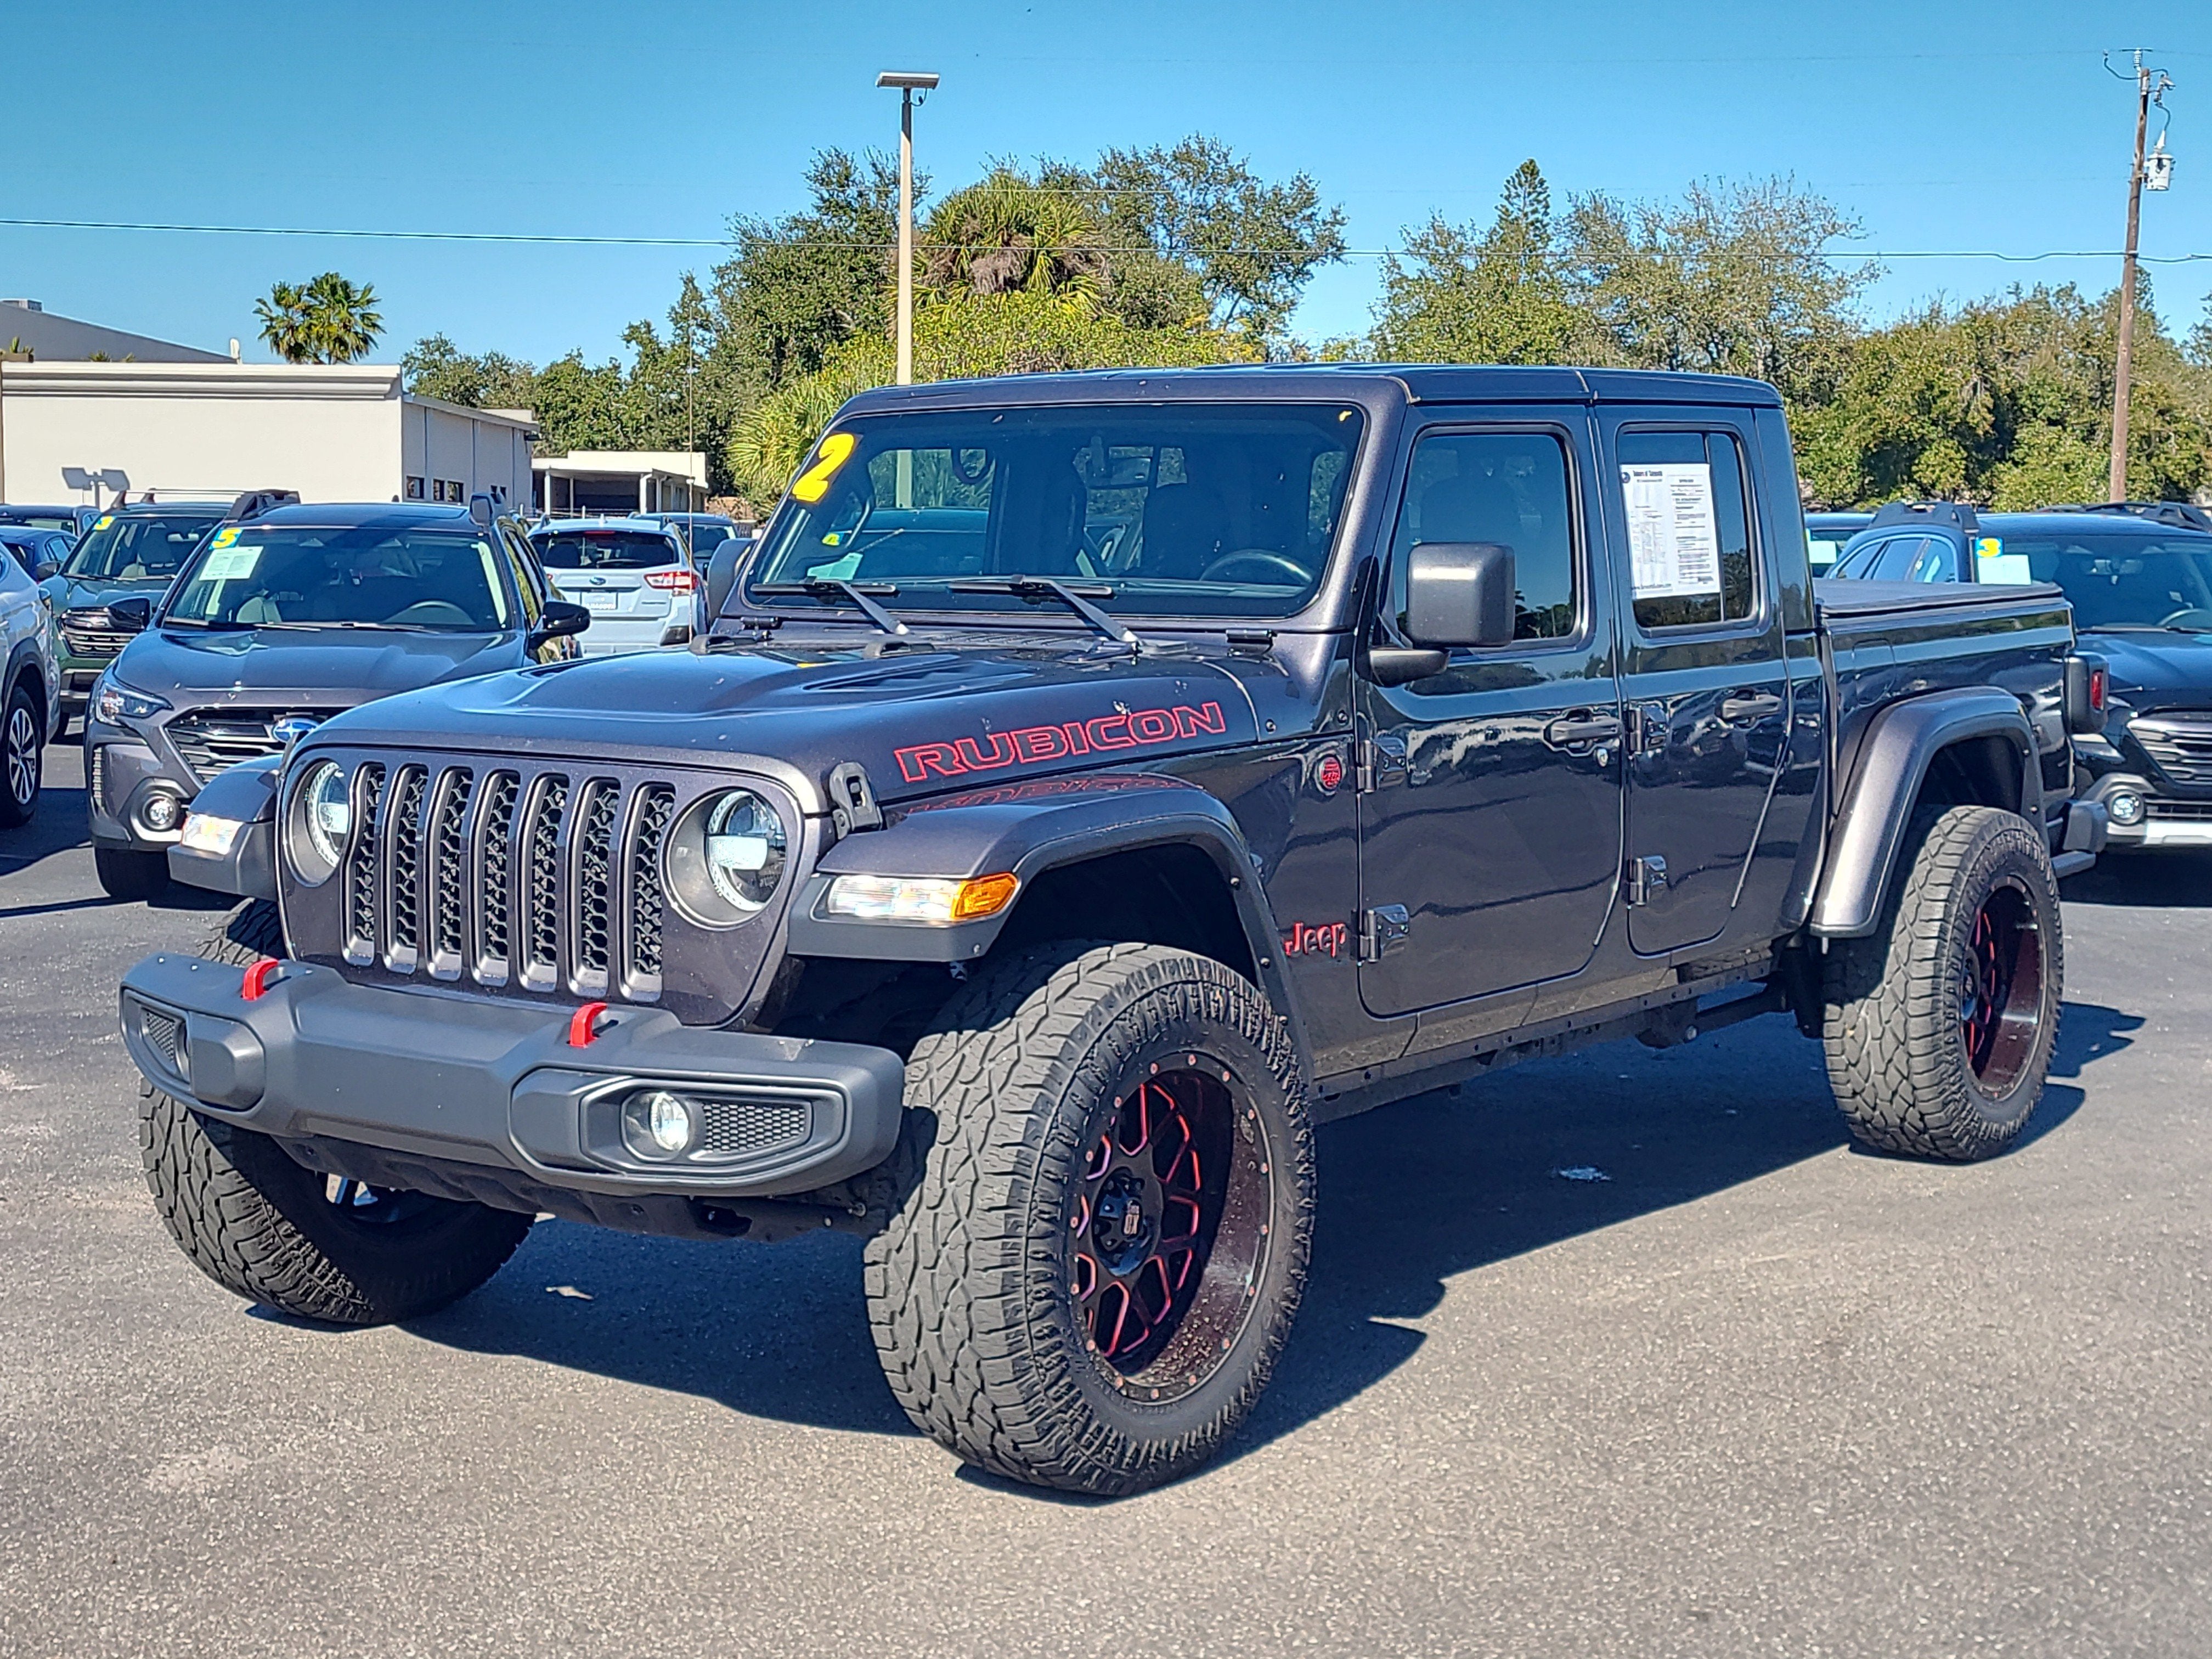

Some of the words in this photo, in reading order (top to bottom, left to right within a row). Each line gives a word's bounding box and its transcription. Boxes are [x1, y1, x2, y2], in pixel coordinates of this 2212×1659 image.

[792, 433, 854, 502] 2
[211, 528, 242, 549] 5
[1976, 538, 2001, 557] 3
[894, 701, 1226, 782] RUBICON
[1284, 922, 1346, 958] Jeep
